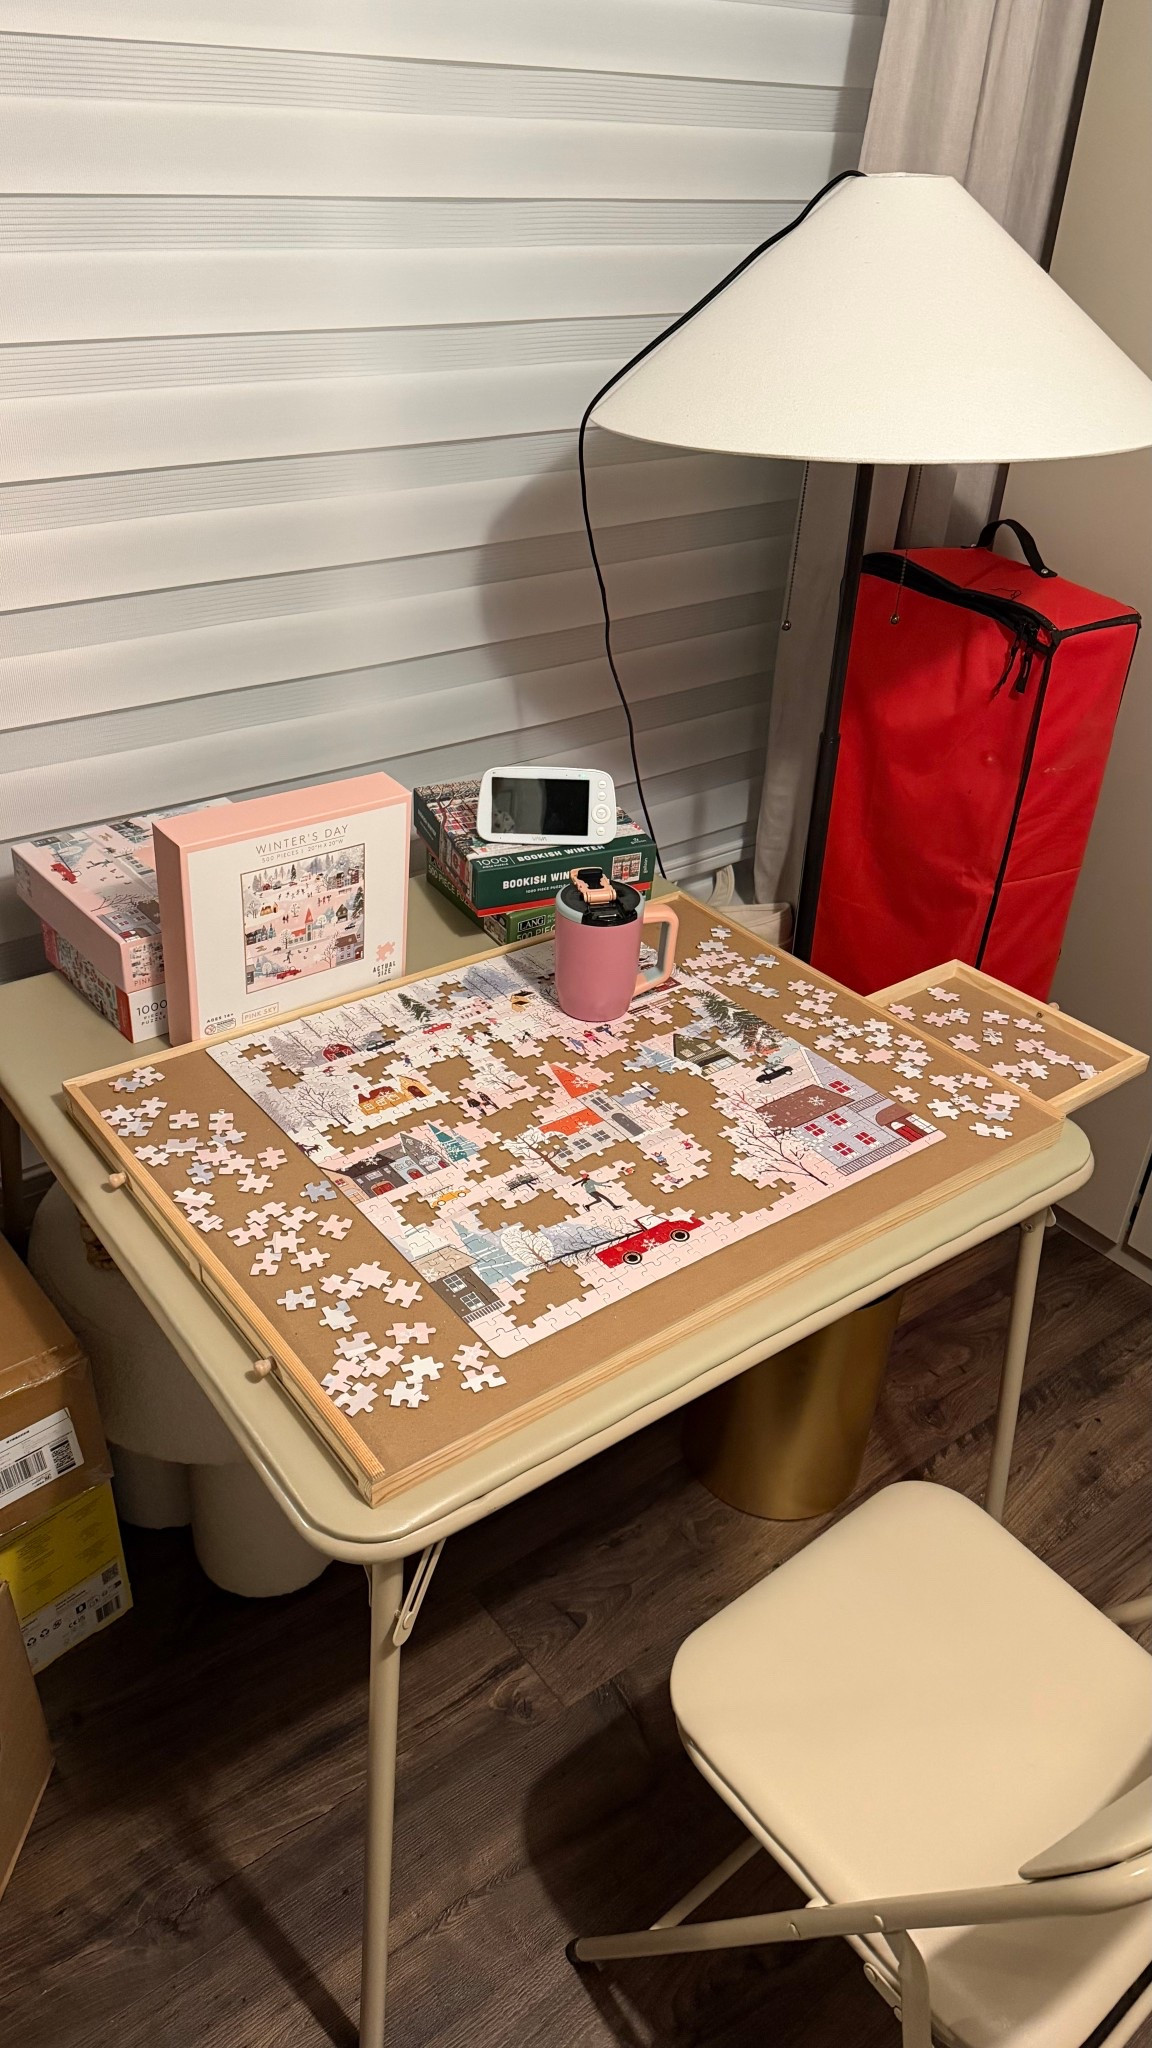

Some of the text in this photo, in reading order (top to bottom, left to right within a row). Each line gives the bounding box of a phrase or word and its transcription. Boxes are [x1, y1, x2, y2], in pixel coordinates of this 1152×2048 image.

[255, 824, 348, 854] WINTER'S DAY
[261, 855, 274, 863] 500
[277, 850, 299, 859] PIECES
[476, 857, 508, 866] 1000
[517, 850, 562, 862] BOOKISH
[564, 845, 605, 856] WINTER
[502, 874, 547, 889] BOOKISH
[520, 917, 544, 930] LANG
[372, 961, 396, 973] ACTUAL
[377, 967, 392, 977] SIZE
[134, 977, 153, 987] PINK
[137, 999, 167, 1016] 1000
[244, 1006, 276, 1020] PINK SKY
[206, 1015, 222, 1023] AGES
